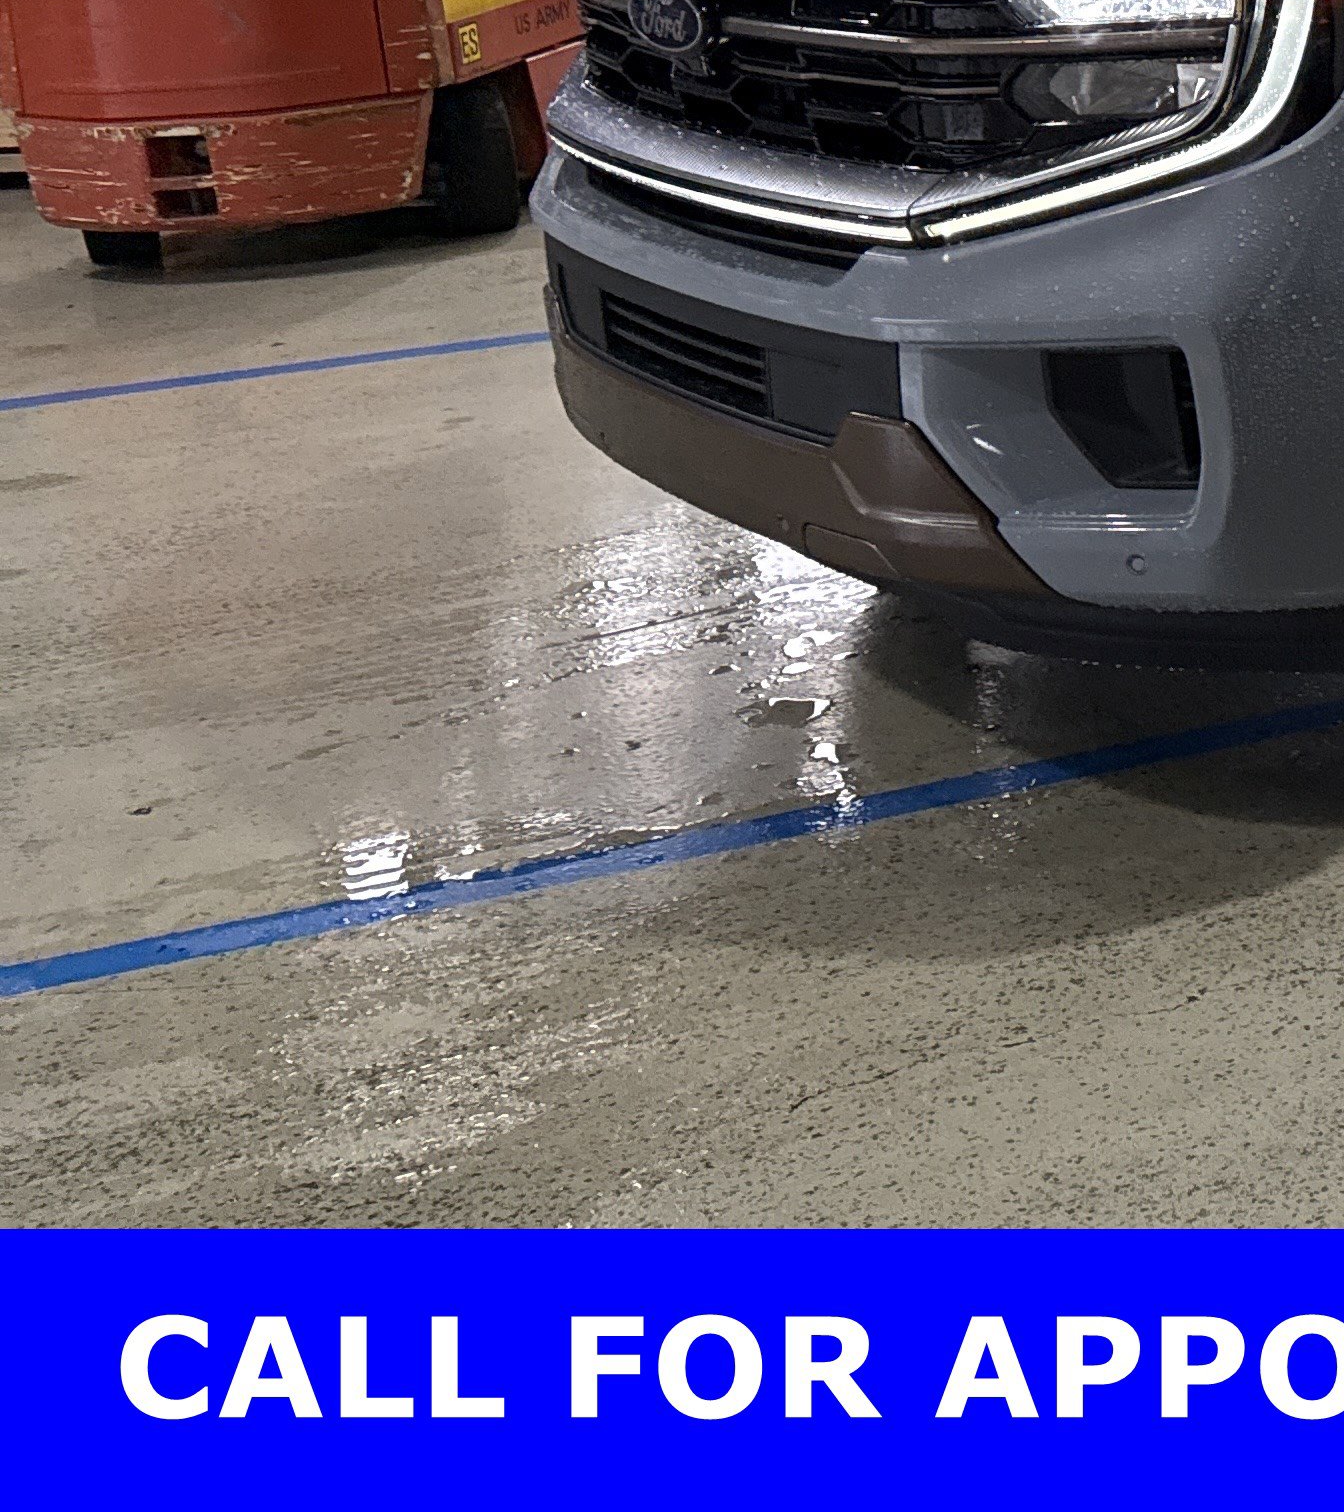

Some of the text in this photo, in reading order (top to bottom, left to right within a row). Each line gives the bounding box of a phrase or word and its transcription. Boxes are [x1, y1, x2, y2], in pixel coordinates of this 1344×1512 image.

[513, 0, 571, 35] US ARMY
[460, 28, 479, 58] ES
